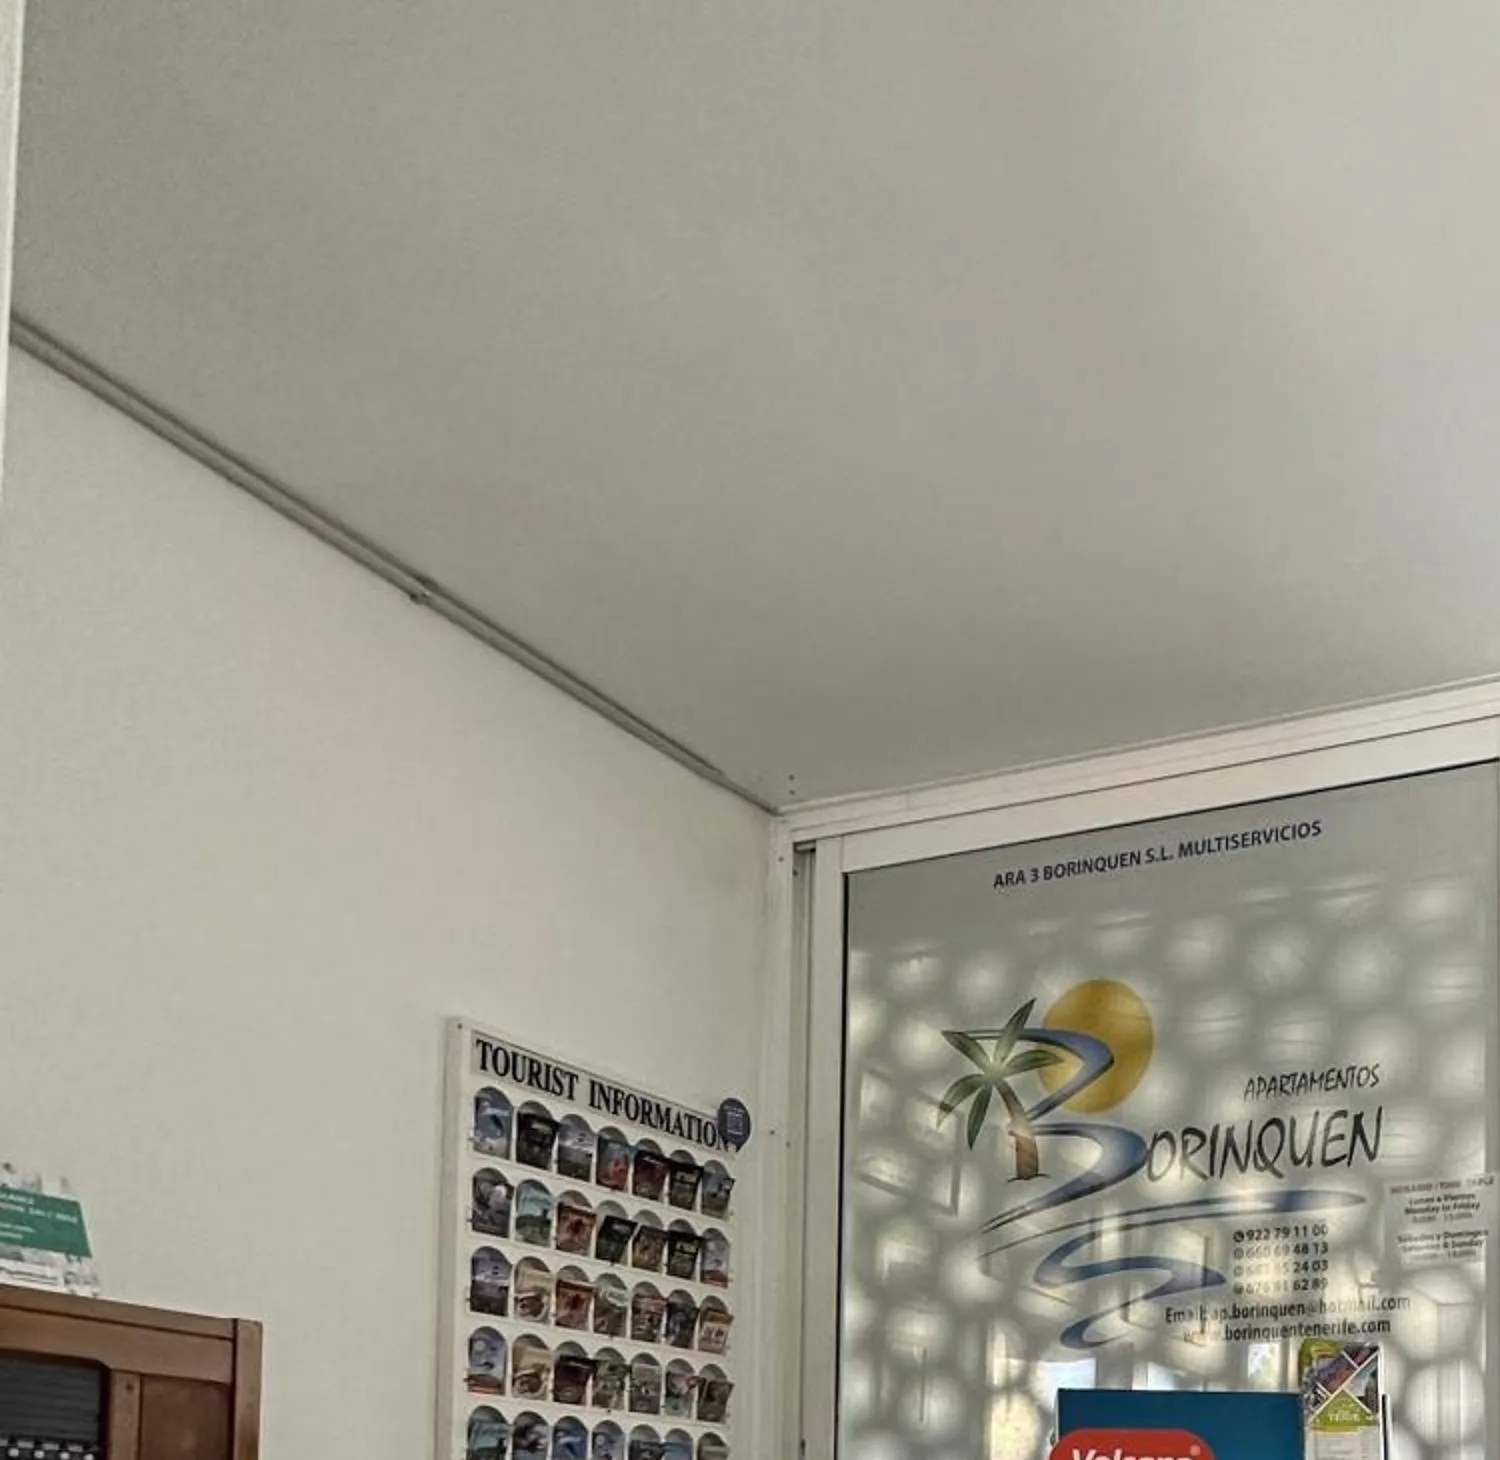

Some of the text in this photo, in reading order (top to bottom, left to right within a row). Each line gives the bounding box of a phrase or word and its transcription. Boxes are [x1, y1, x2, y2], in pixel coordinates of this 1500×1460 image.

[993, 820, 1322, 889] ARA 3 BORINQUEN S.L. MULTISERVICIOS
[476, 1039, 579, 1101] TOURIST
[1243, 1063, 1381, 1102] APARTAMENTOS
[1246, 1224, 1329, 1241] 922 79 11 00
[1313, 1241, 1328, 1254] 13
[1293, 1261, 1309, 1274] 24
[1312, 1259, 1328, 1272] 03
[1184, 1318, 1391, 1343] w.borinquentenerife.com
